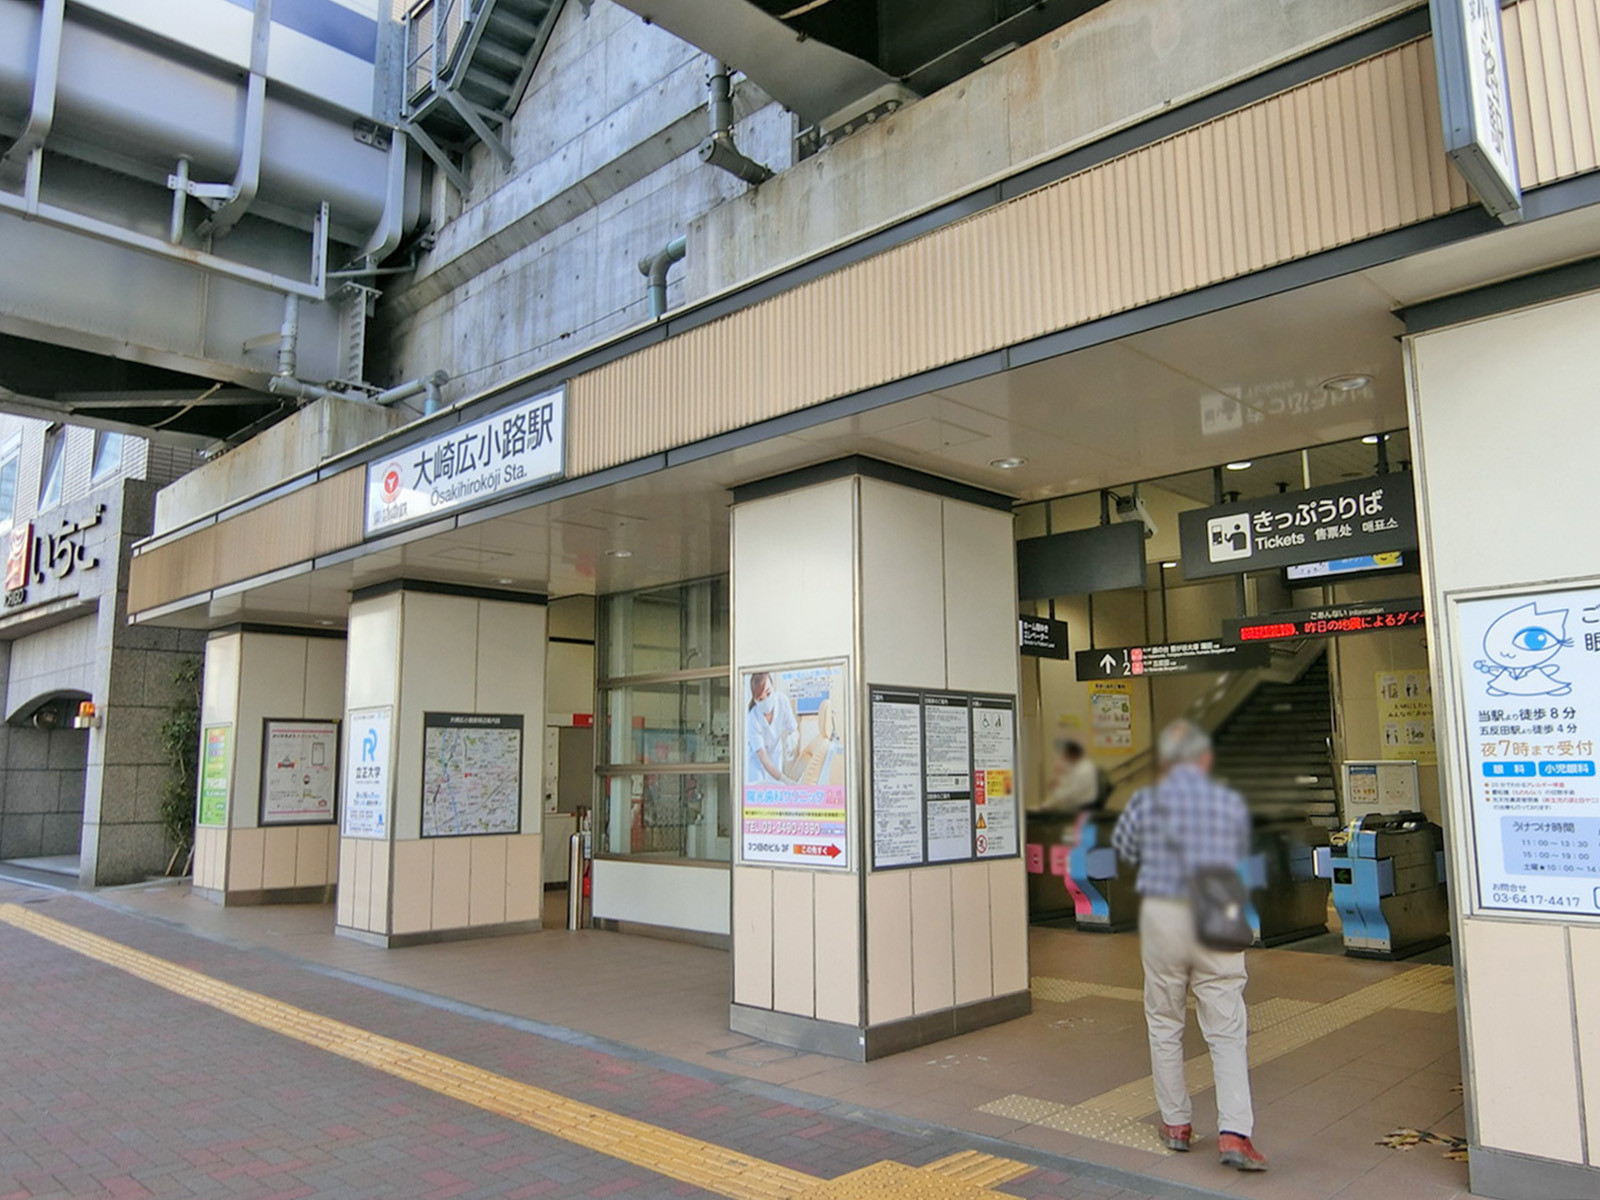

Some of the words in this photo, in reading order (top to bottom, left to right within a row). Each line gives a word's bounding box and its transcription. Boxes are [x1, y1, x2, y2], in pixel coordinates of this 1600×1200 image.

[413, 403, 553, 491] 大崎広小路駅
[504, 464, 528, 483] Sta.
[1253, 489, 1384, 532] きっぷうりば
[31, 504, 107, 584] いちご
[1255, 532, 1305, 550] Tickets
[1123, 649, 1128, 662] 1
[1123, 662, 1131, 675] 2
[1481, 739, 1593, 757] 夜7時まで受付
[356, 766, 381, 779] 立正大学
[1512, 821, 1575, 833] うけつけ時間
[1492, 892, 1580, 907] 03-6417-4417
